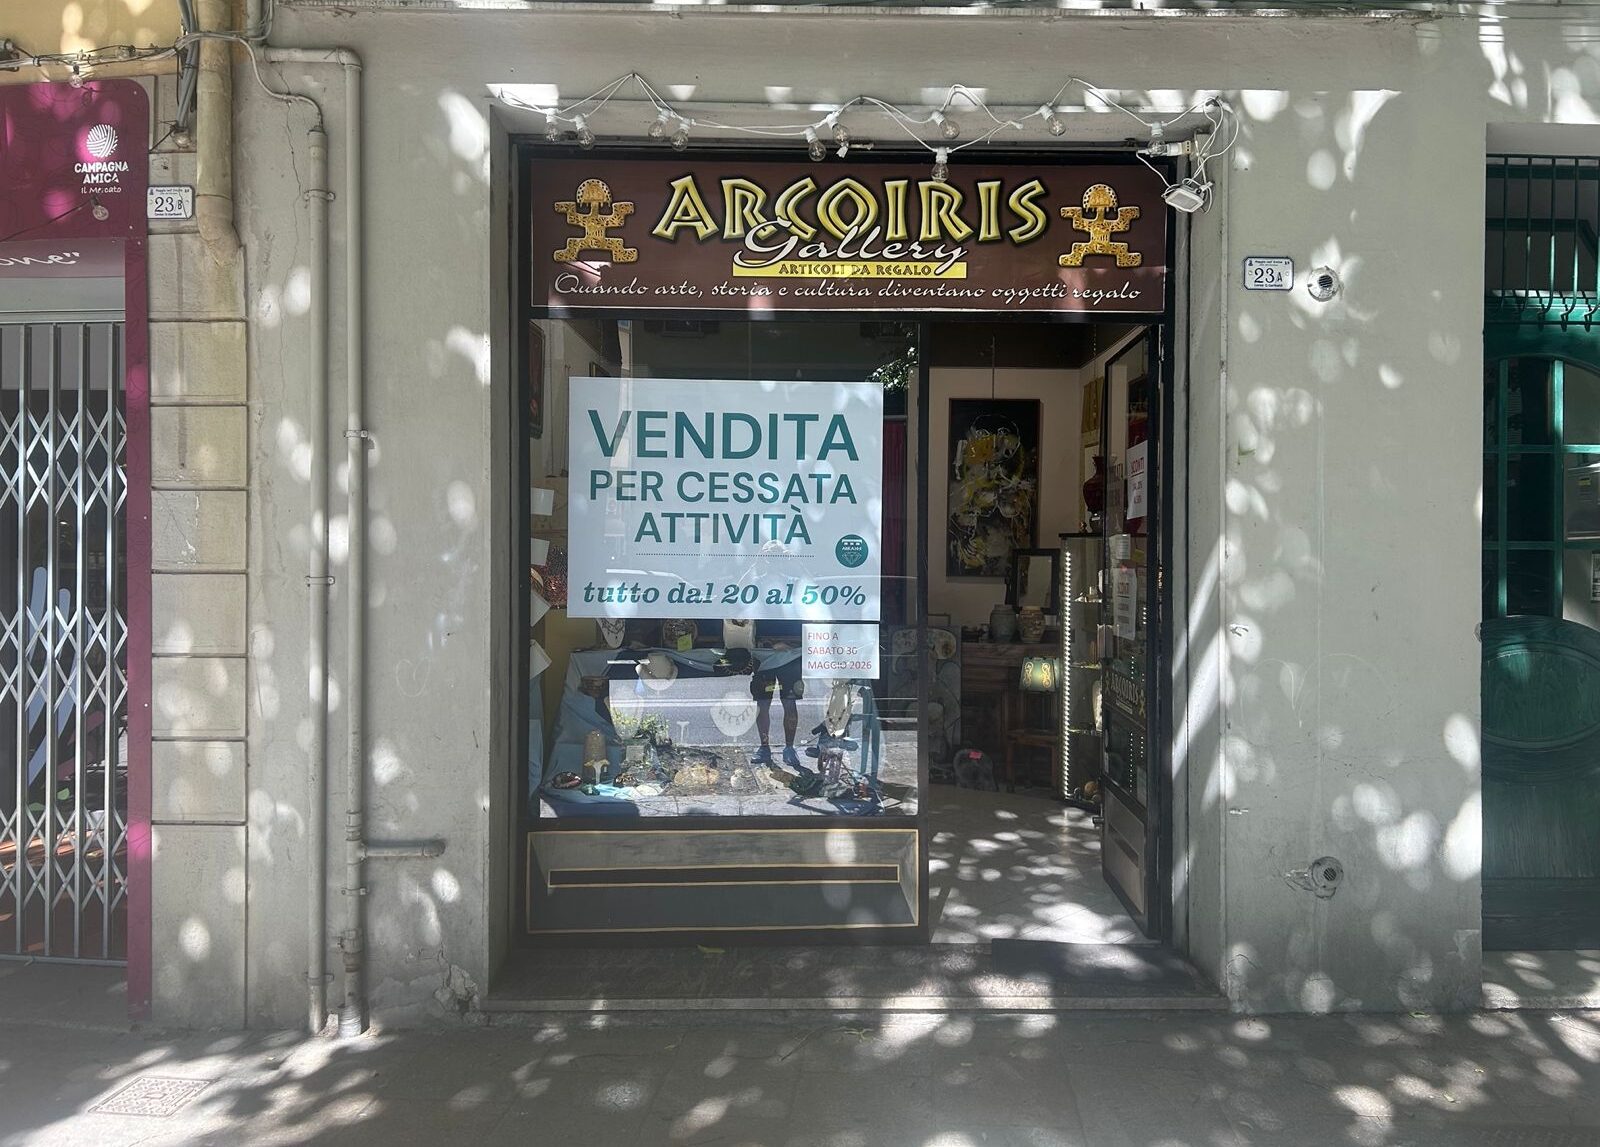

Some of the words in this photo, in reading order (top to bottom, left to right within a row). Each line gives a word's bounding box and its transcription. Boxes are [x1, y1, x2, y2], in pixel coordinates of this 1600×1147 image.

[74, 161, 129, 173] CAMPAGNA
[83, 172, 119, 184] AMICA
[651, 175, 1047, 244] ARCOIRIS
[733, 216, 968, 275] Gallery
[778, 263, 846, 276] ARTICOLI
[850, 264, 871, 276] DA
[876, 264, 932, 276] REGALO
[554, 272, 649, 295] Quando
[654, 280, 704, 297] arte,
[711, 280, 773, 297] storia
[778, 286, 789, 296] e
[794, 279, 873, 297] cultura
[878, 279, 986, 298] diventano
[992, 281, 1068, 304] oggetti
[1072, 281, 1141, 305] regalo
[587, 409, 860, 462] VENDITA
[589, 470, 664, 502] PER
[676, 471, 857, 504] CESSATA
[634, 504, 812, 545] ATTIVITÀ
[583, 581, 660, 604] tutto
[667, 583, 714, 604] dal
[720, 584, 759, 605] 20
[766, 583, 795, 605] al
[802, 584, 867, 606] 50%
[807, 632, 830, 641] FINO
[831, 632, 839, 641] A
[807, 646, 844, 655] SABATO
[807, 660, 848, 670] MAGGIO
[850, 660, 872, 670] 2026
